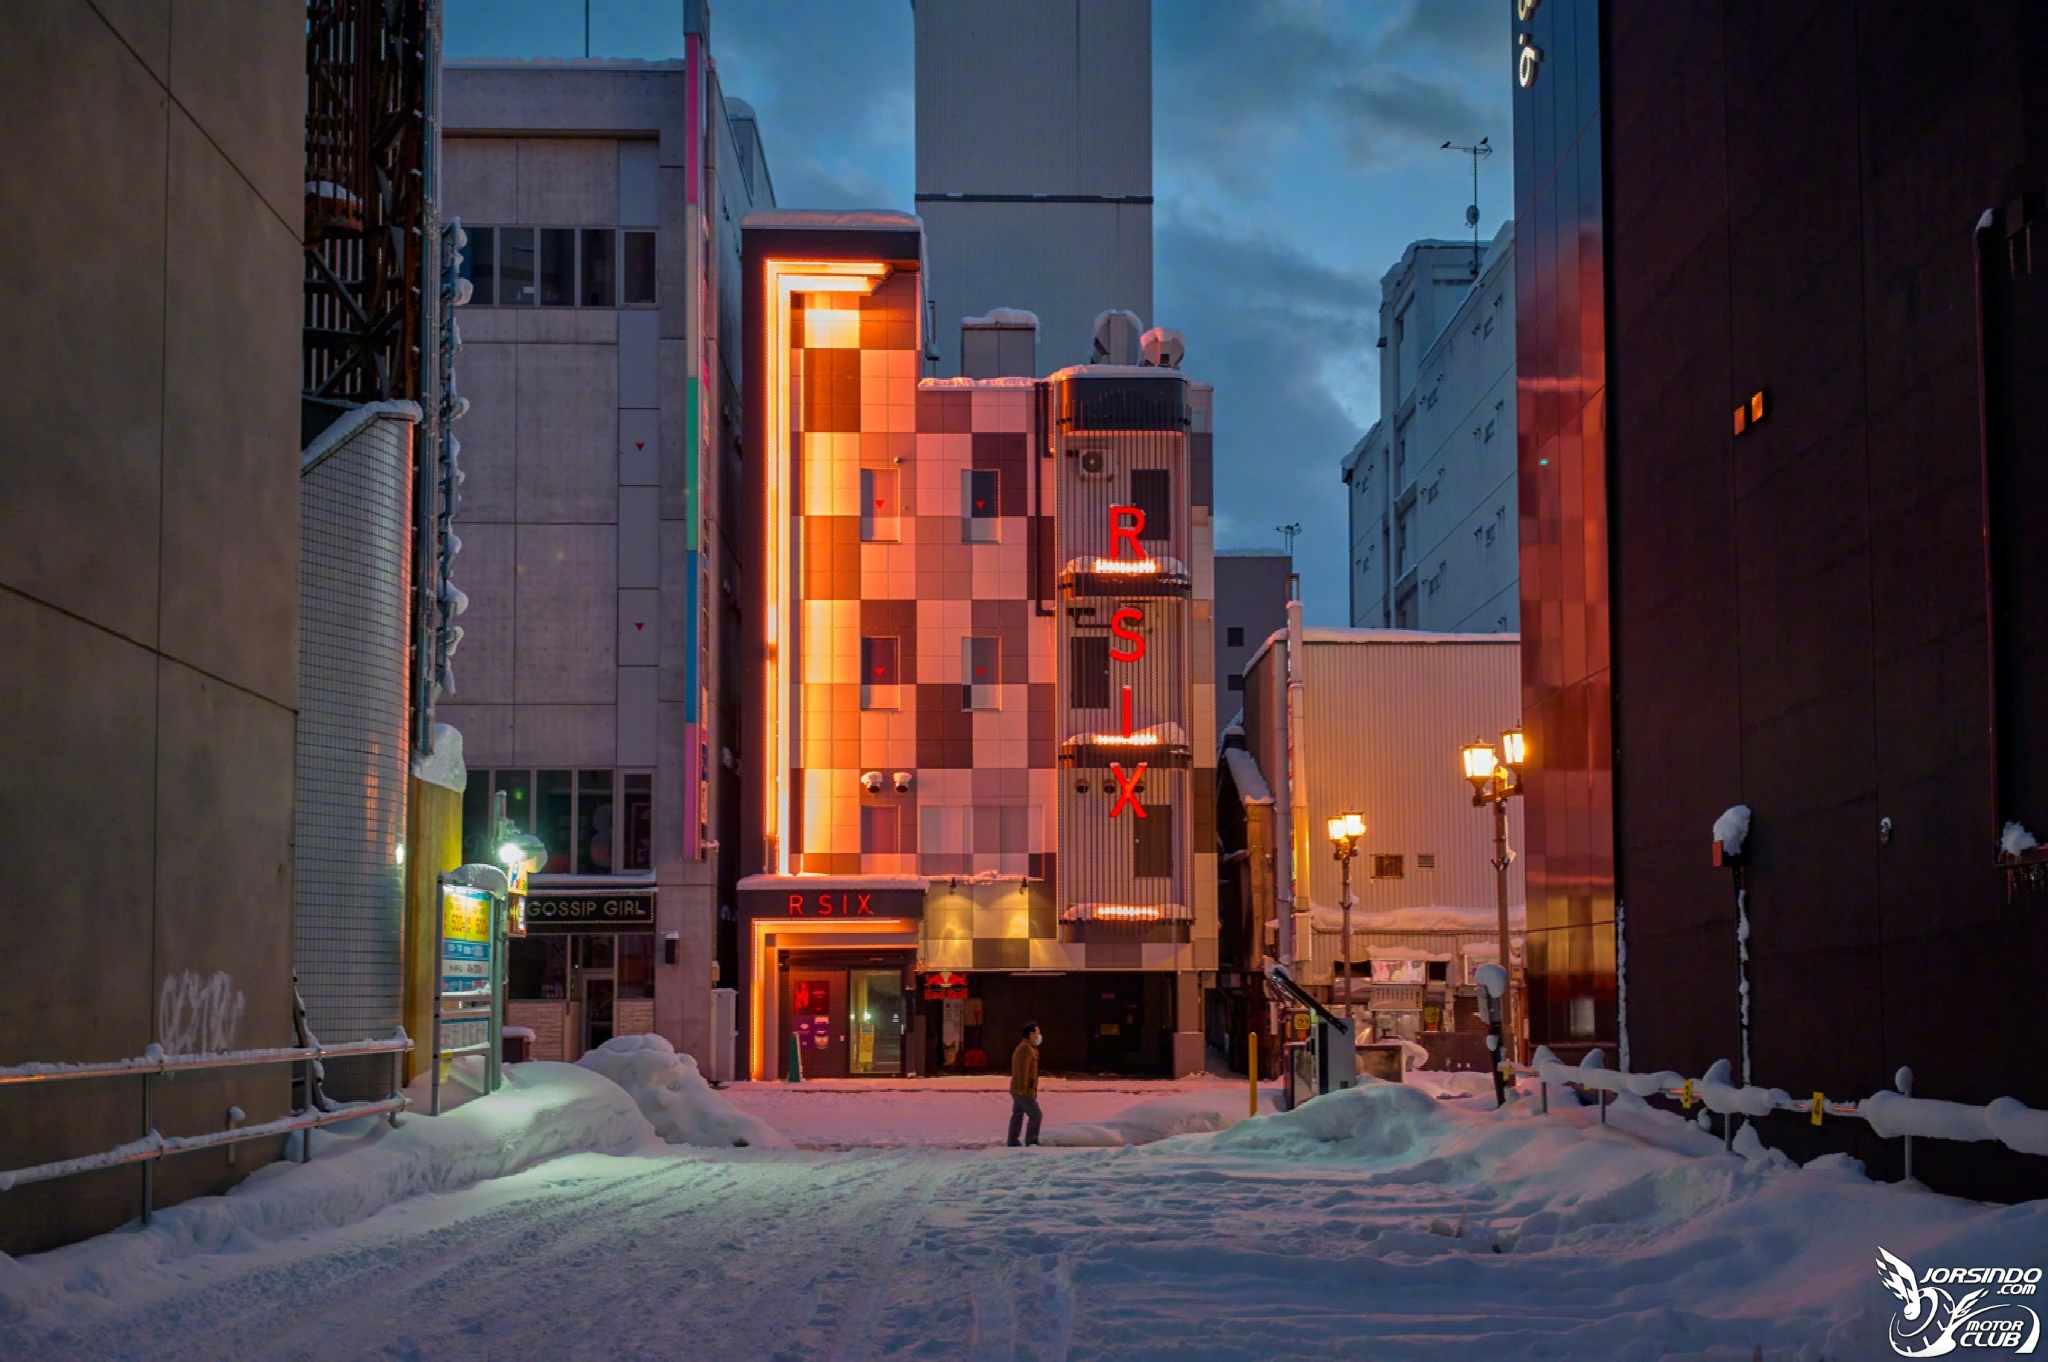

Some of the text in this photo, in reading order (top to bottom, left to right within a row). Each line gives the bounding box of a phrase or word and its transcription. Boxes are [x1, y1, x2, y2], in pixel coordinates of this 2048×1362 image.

[1108, 504, 1147, 559] R
[526, 900, 597, 917] GOSSIP
[603, 900, 646, 917] GIRL
[788, 893, 873, 916] R SIX
